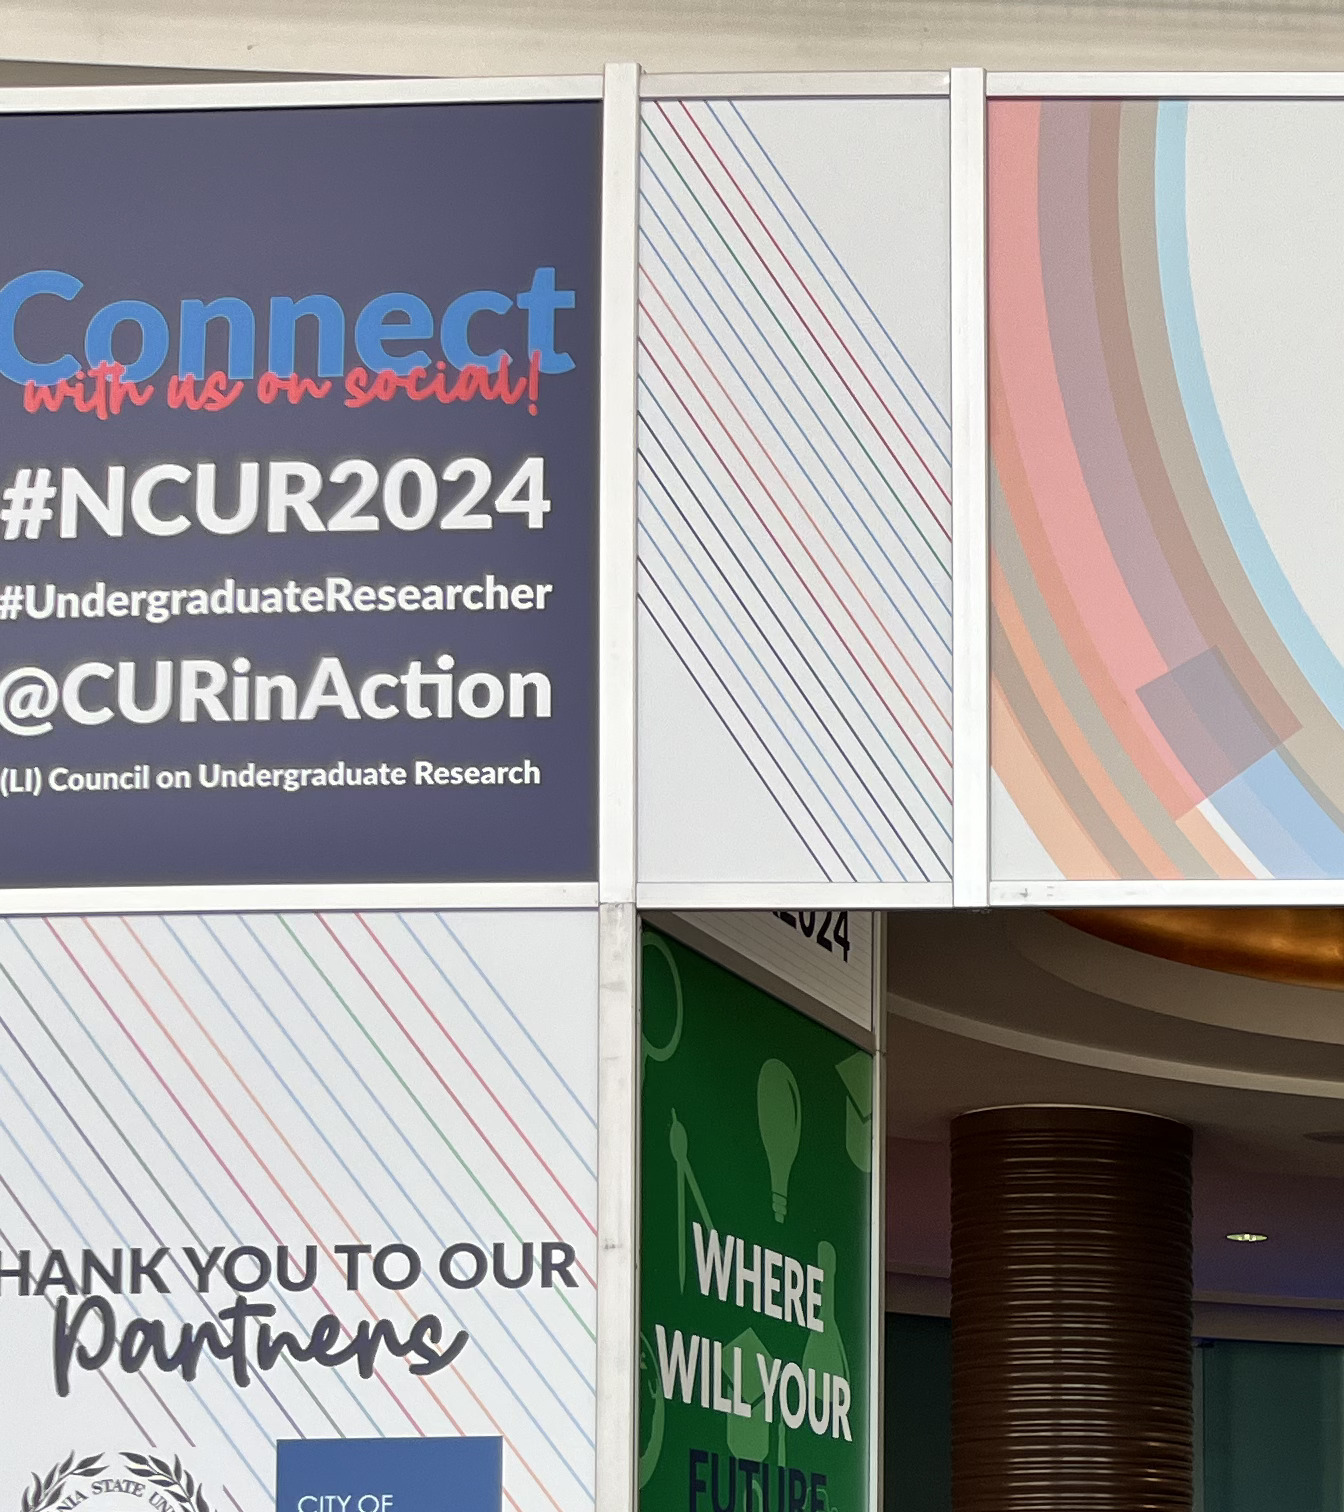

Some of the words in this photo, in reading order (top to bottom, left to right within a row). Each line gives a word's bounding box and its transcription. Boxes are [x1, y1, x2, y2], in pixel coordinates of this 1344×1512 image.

[0, 267, 576, 386] Connect
[23, 361, 153, 420] with
[167, 371, 244, 412] us
[257, 371, 332, 406] on
[344, 350, 541, 417] social!
[2, 457, 551, 540] #NCUR2024
[0, 575, 552, 623] #UndergraduateResearcher
[0, 655, 552, 736] @CURinAction
[0, 765, 42, 797] (LI)
[49, 764, 150, 790] Council
[156, 769, 191, 789] on
[198, 762, 407, 793] Undergraduate
[414, 760, 540, 786] Research
[0, 1246, 171, 1297] HANK
[182, 1245, 318, 1294] YOU
[335, 1243, 421, 1291] TO
[439, 1241, 579, 1289] OUR
[692, 1221, 825, 1334] WHERE
[53, 1295, 469, 1398] Partners
[655, 1323, 752, 1419] WILL
[759, 1360, 852, 1442] YOUR
[91, 1479, 146, 1497] STATE
